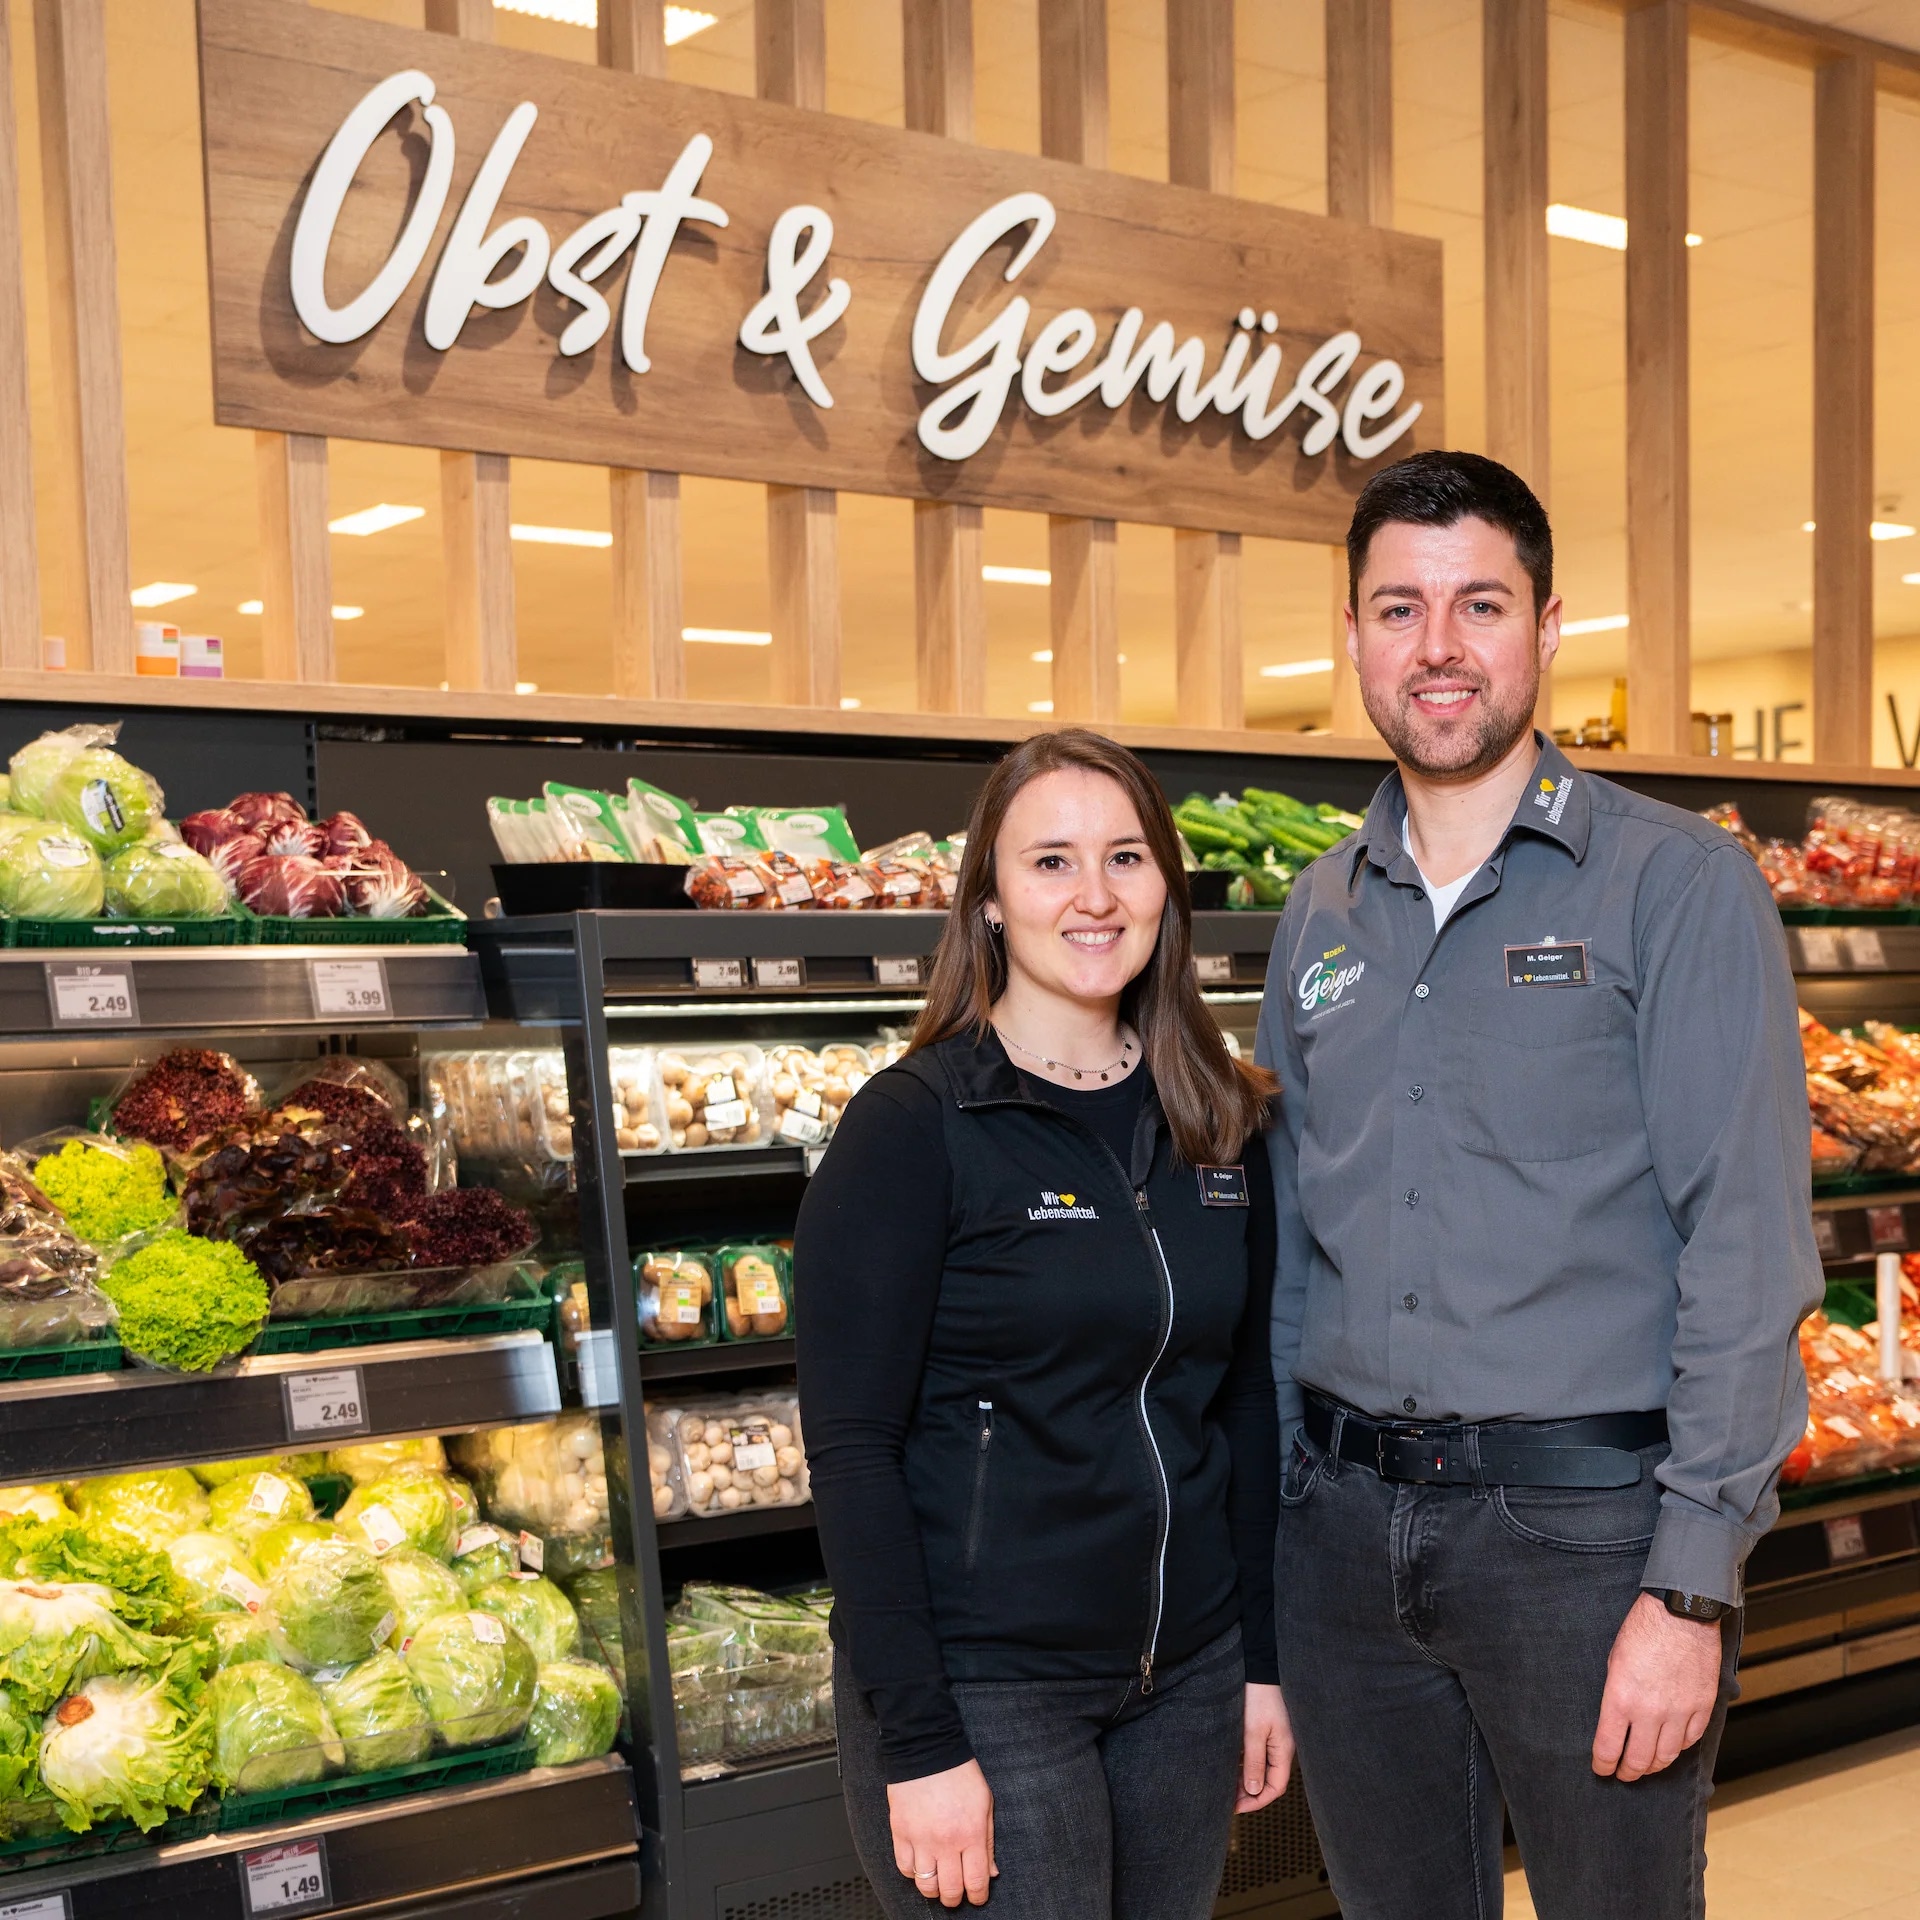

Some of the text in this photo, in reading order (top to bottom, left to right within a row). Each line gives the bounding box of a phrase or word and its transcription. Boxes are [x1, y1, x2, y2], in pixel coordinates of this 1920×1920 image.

[289, 69, 1423, 462] Obst & Gemüse
[1534, 791, 1551, 808] Wir
[1323, 944, 1346, 960] EDEKA
[1538, 954, 1563, 962] Geiger
[1298, 961, 1365, 1011] Geiger
[1513, 975, 1523, 983] Wir
[88, 996, 127, 1012] 2.49
[346, 990, 381, 1006] 3.99
[1041, 1191, 1060, 1206] Wir
[1028, 1206, 1100, 1221] Lebensmittel.
[321, 1402, 358, 1421] 2.49
[281, 1875, 320, 1898] 1.49
